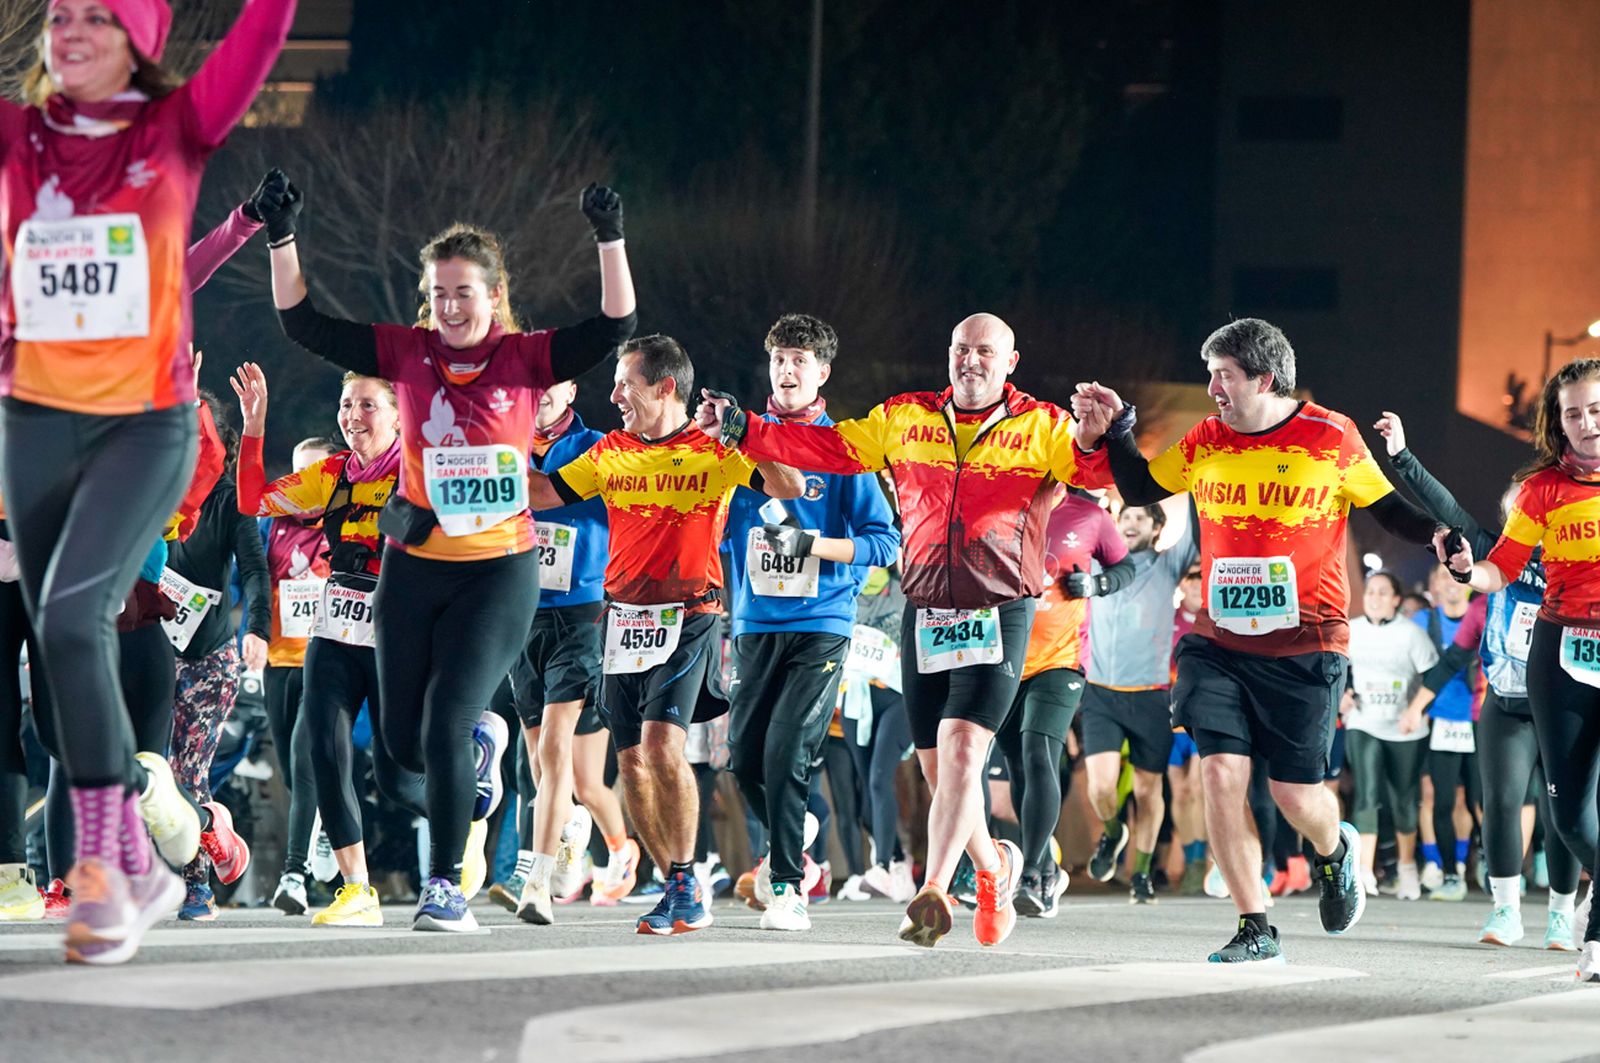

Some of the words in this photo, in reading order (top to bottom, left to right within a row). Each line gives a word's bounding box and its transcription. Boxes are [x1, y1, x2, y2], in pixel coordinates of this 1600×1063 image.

[40, 262, 118, 297] 5487
[901, 425, 952, 446] ¡ANSI
[447, 457, 475, 466] NOCHE
[477, 456, 488, 465] DE
[436, 468, 455, 478] SAN
[655, 471, 709, 494] VIVA!
[438, 477, 516, 505] 13209
[1258, 482, 1329, 511] VIVA!
[755, 542, 766, 551] SAN
[761, 552, 805, 574] 6487
[1227, 566, 1250, 575] NOCHE
[1252, 566, 1262, 574] DE
[1217, 576, 1233, 585] SAN
[328, 589, 340, 597] SAN
[1218, 585, 1286, 609] 12298
[330, 597, 373, 623] 5491
[616, 619, 631, 627] SAN
[925, 620, 943, 628] SAN
[1572, 628, 1588, 638] SAN
[620, 628, 667, 650] 4550
[931, 620, 984, 647] 2434
[854, 642, 885, 661] 6573
